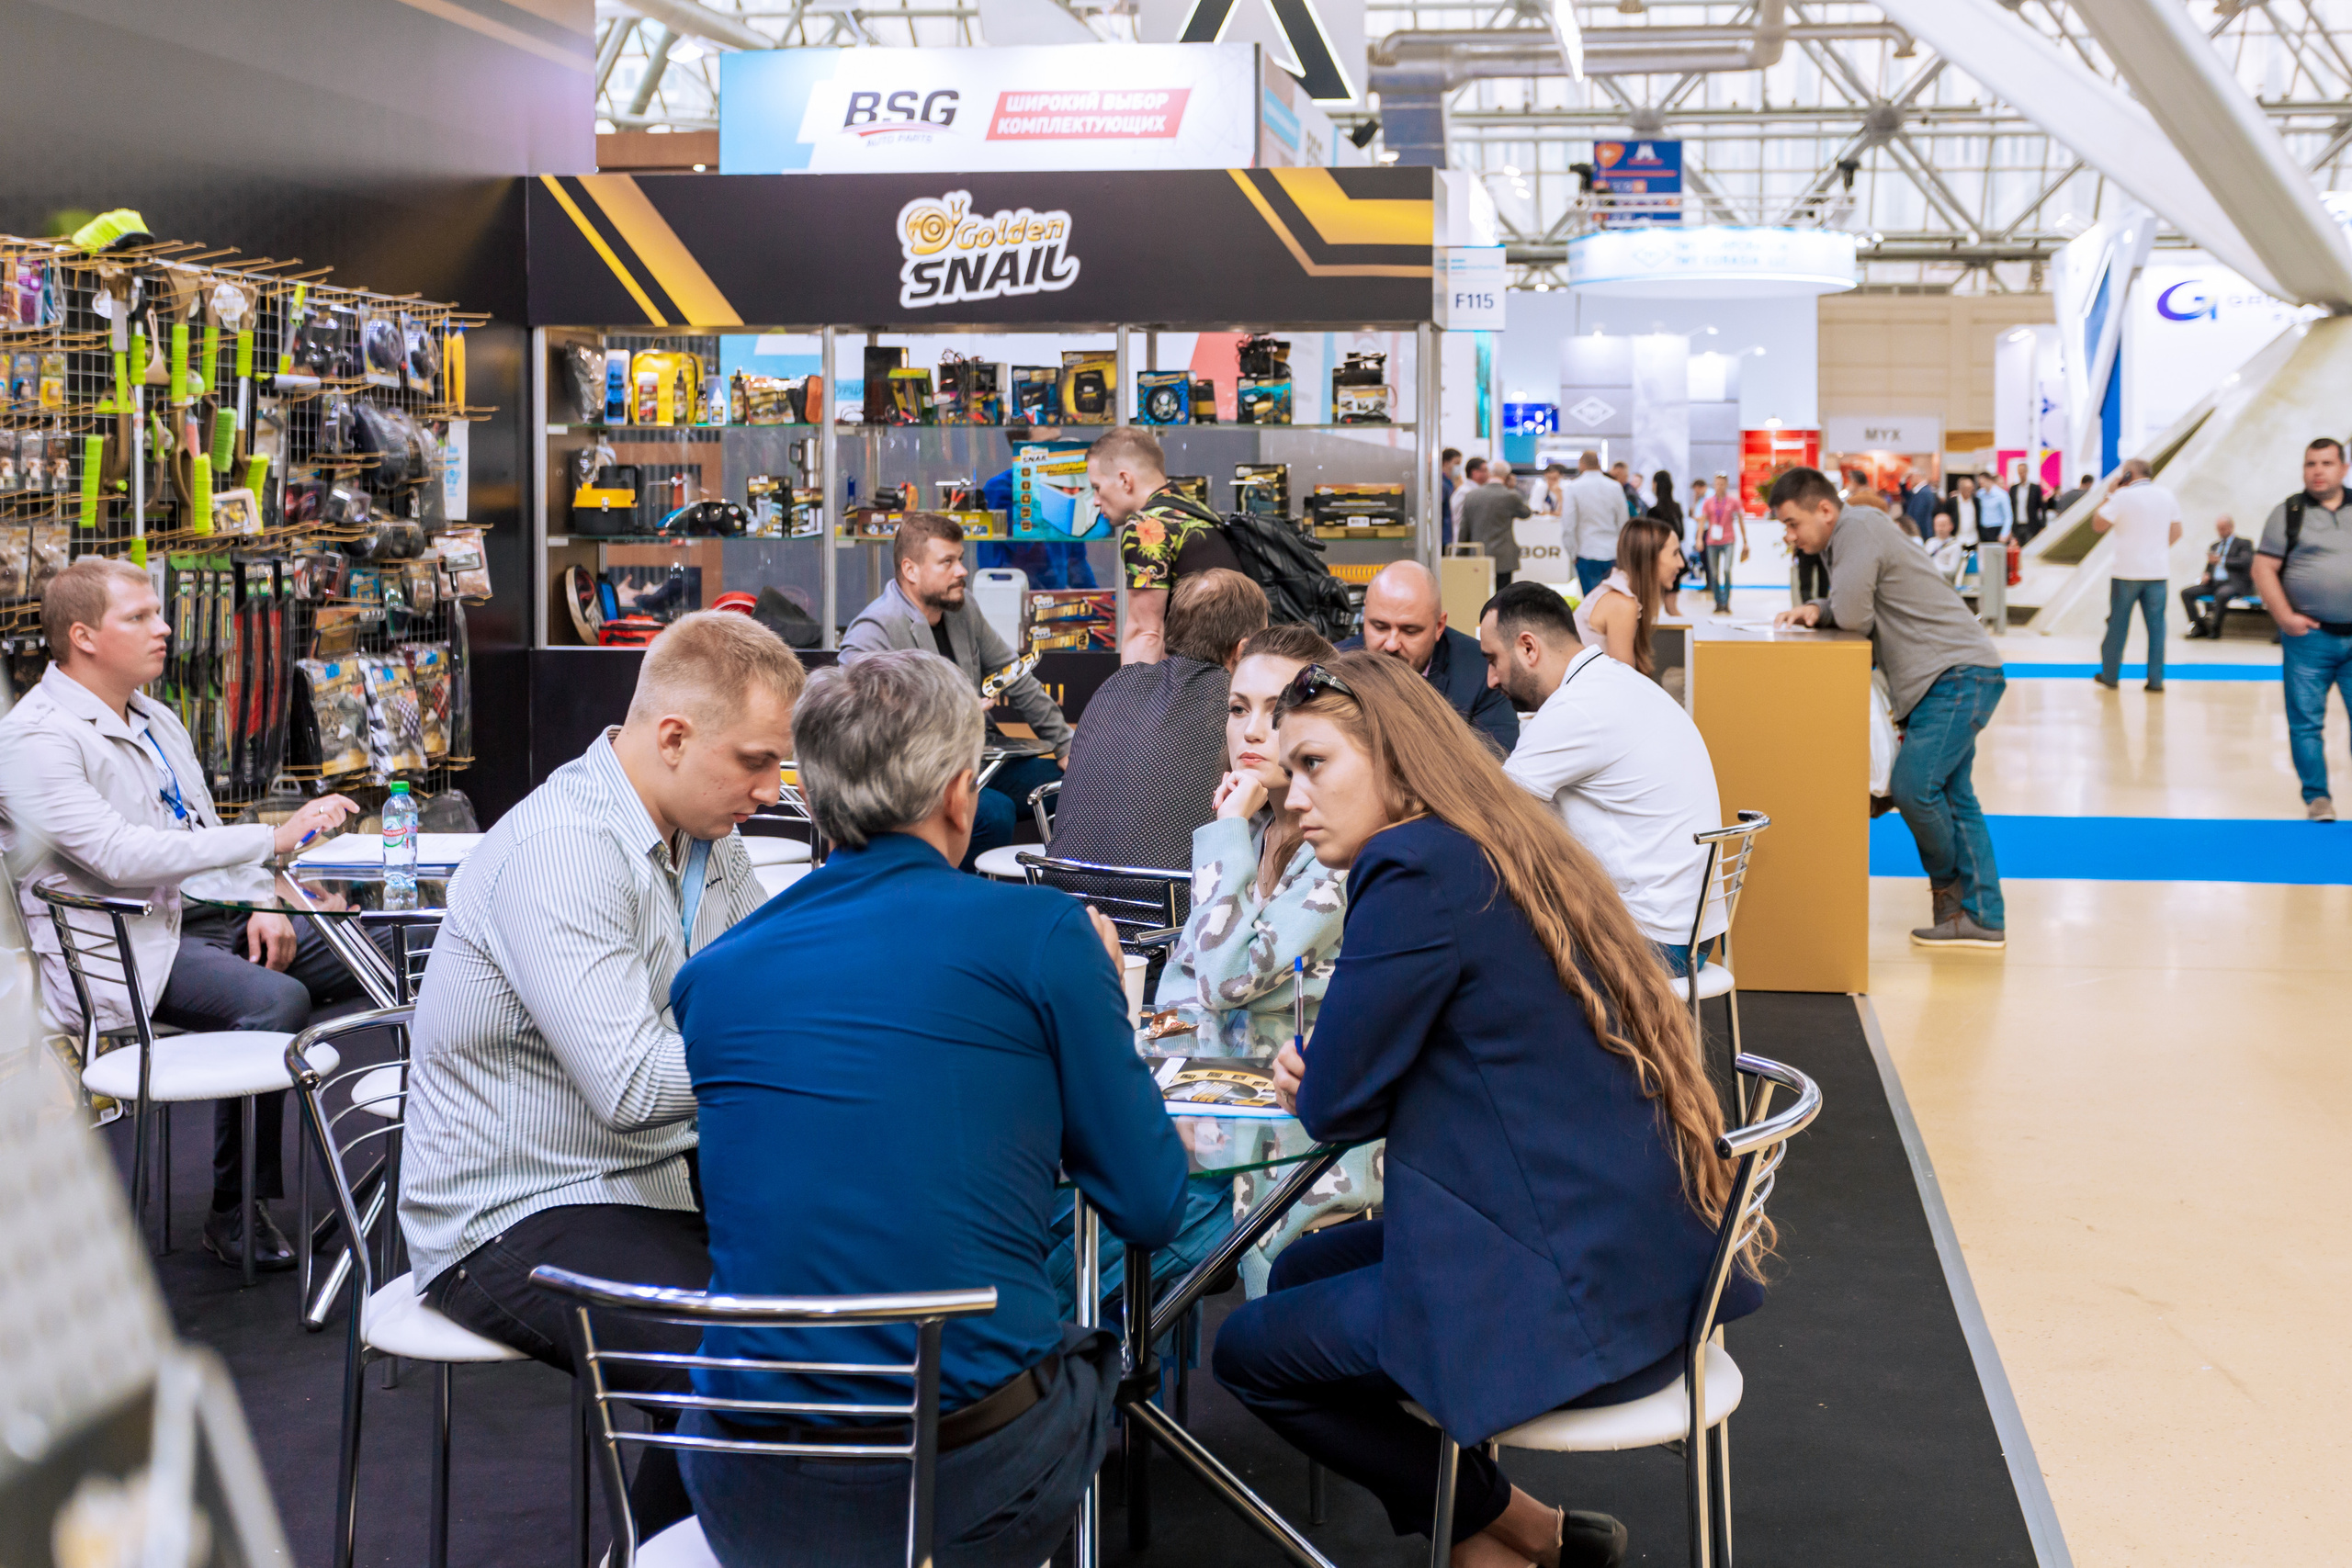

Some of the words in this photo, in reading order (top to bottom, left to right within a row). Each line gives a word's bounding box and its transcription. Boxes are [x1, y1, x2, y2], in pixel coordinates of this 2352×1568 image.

[843, 90, 959, 127] BSG
[1005, 91, 1101, 112] ШИРОКИЙ
[1102, 93, 1170, 111] ВЫБОР
[997, 115, 1168, 135] КОМПЛЕКТУЮЩИХ
[956, 217, 1064, 250] Golden
[909, 244, 1074, 300] SNAIL
[1455, 293, 1494, 310] F115
